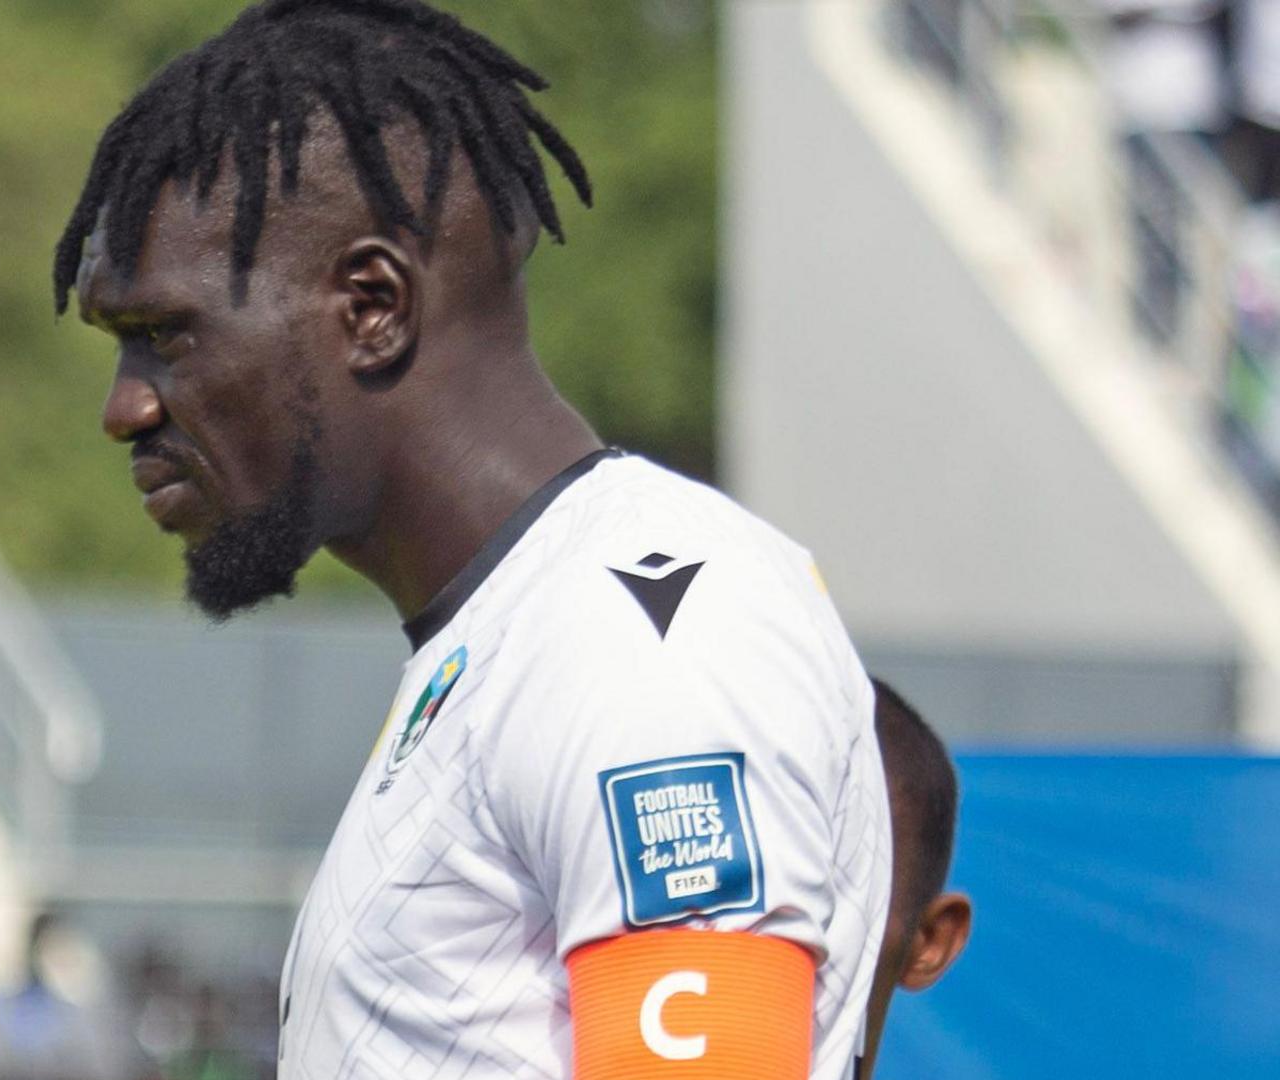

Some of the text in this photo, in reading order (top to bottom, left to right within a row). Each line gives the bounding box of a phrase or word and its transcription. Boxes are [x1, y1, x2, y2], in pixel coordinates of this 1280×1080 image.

[633, 782, 718, 815] FOOTBALL
[638, 805, 724, 846] UNITES
[639, 833, 734, 874] the World
[674, 875, 710, 891] FIFA
[639, 971, 707, 1060] C
